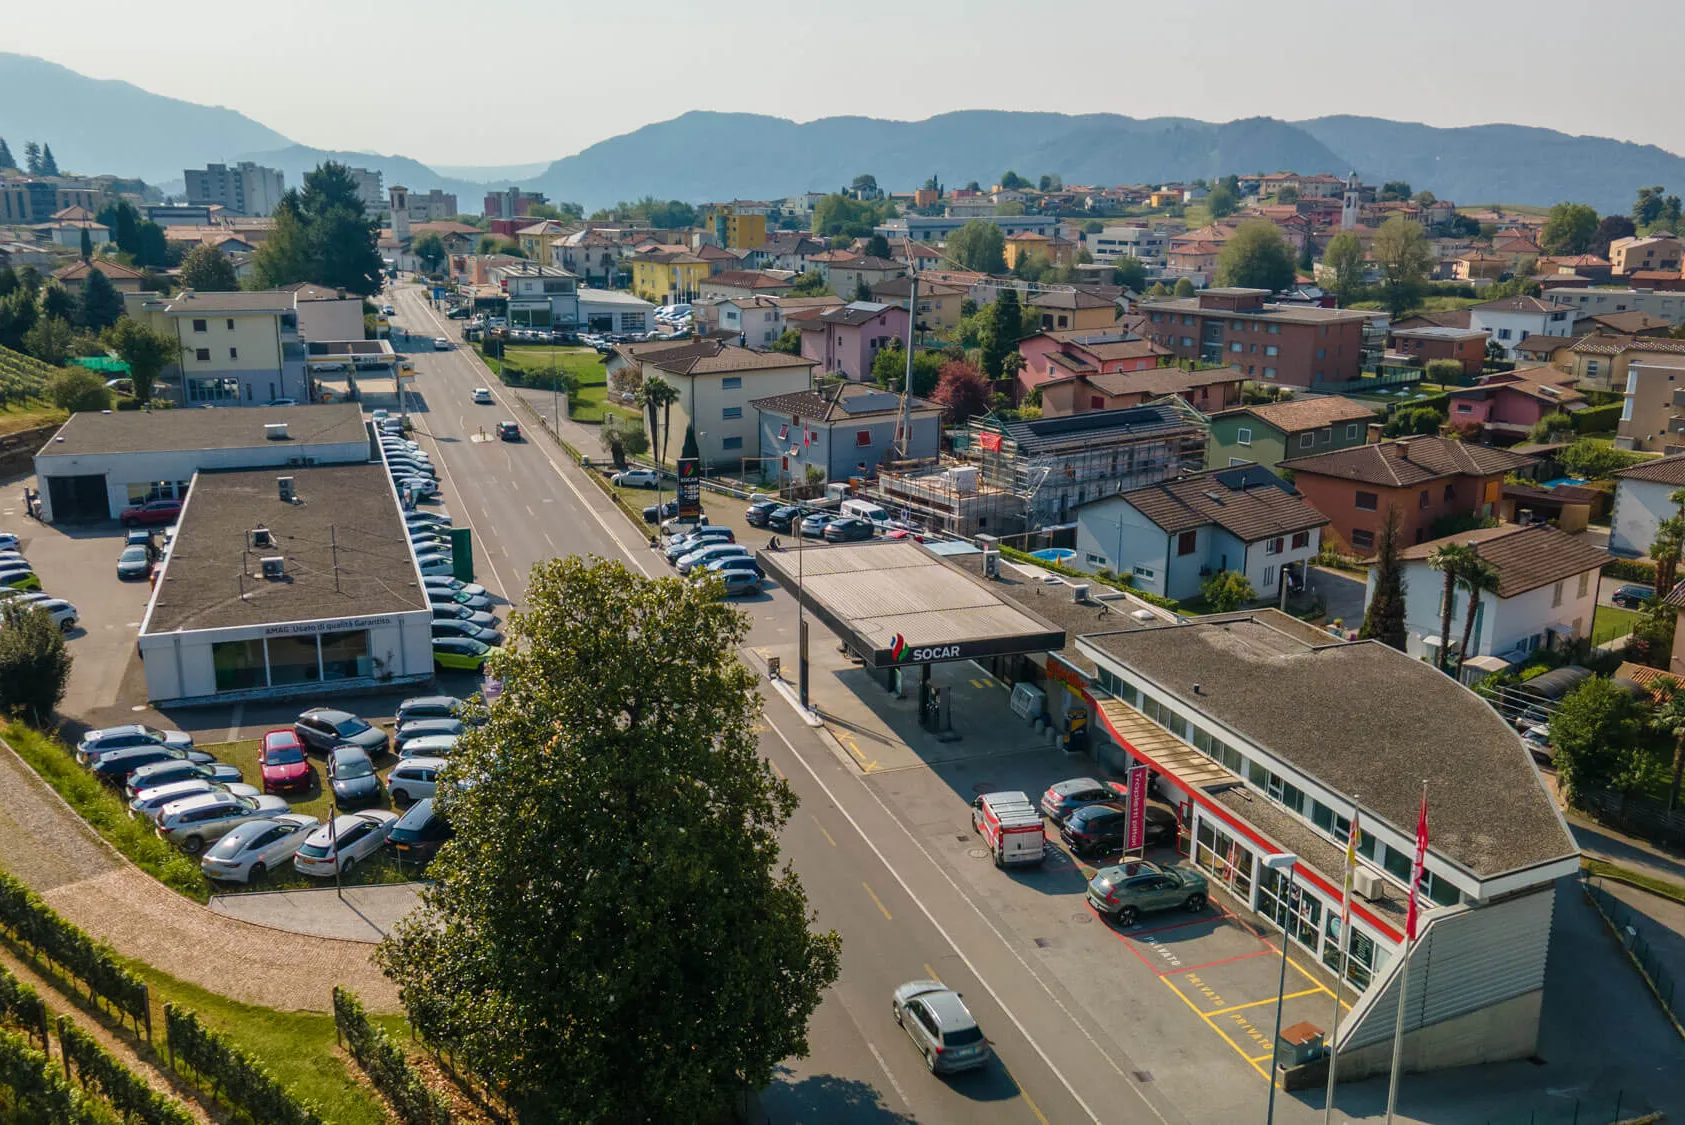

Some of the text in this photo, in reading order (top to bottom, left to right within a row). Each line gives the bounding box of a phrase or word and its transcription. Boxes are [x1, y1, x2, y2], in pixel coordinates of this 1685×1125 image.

[292, 624, 316, 633] Usato
[913, 645, 960, 660] SOCAR
[1144, 936, 1181, 966] PRIVATO
[1185, 973, 1226, 1006] PRIVATO
[1229, 1014, 1274, 1050] PRIVATO
